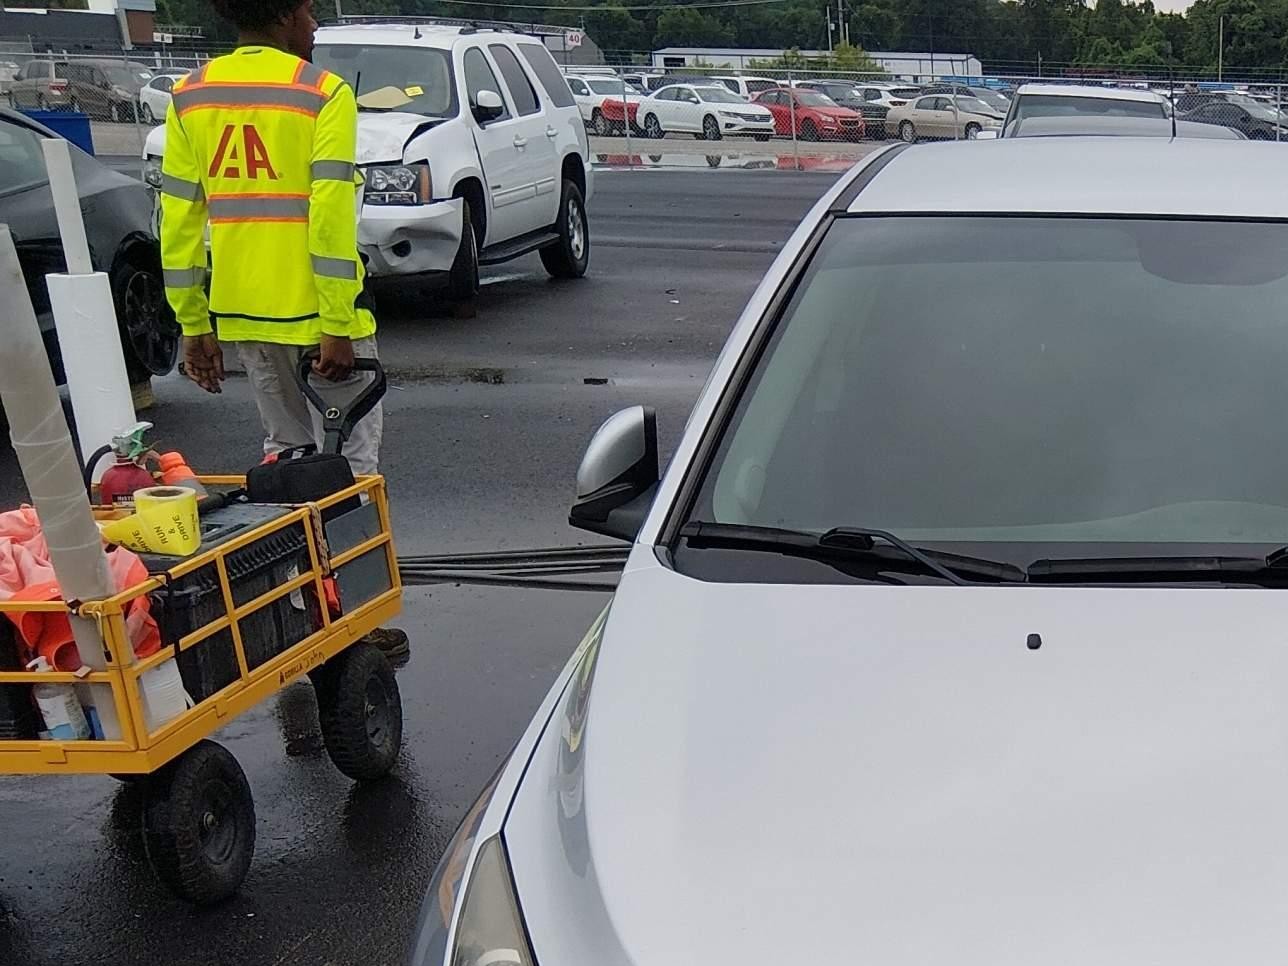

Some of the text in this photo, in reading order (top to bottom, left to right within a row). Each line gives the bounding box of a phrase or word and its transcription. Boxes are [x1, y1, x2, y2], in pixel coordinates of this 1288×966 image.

[569, 34, 580, 43] 40
[154, 525, 169, 545] RUN
[172, 514, 190, 541] DRIVE
